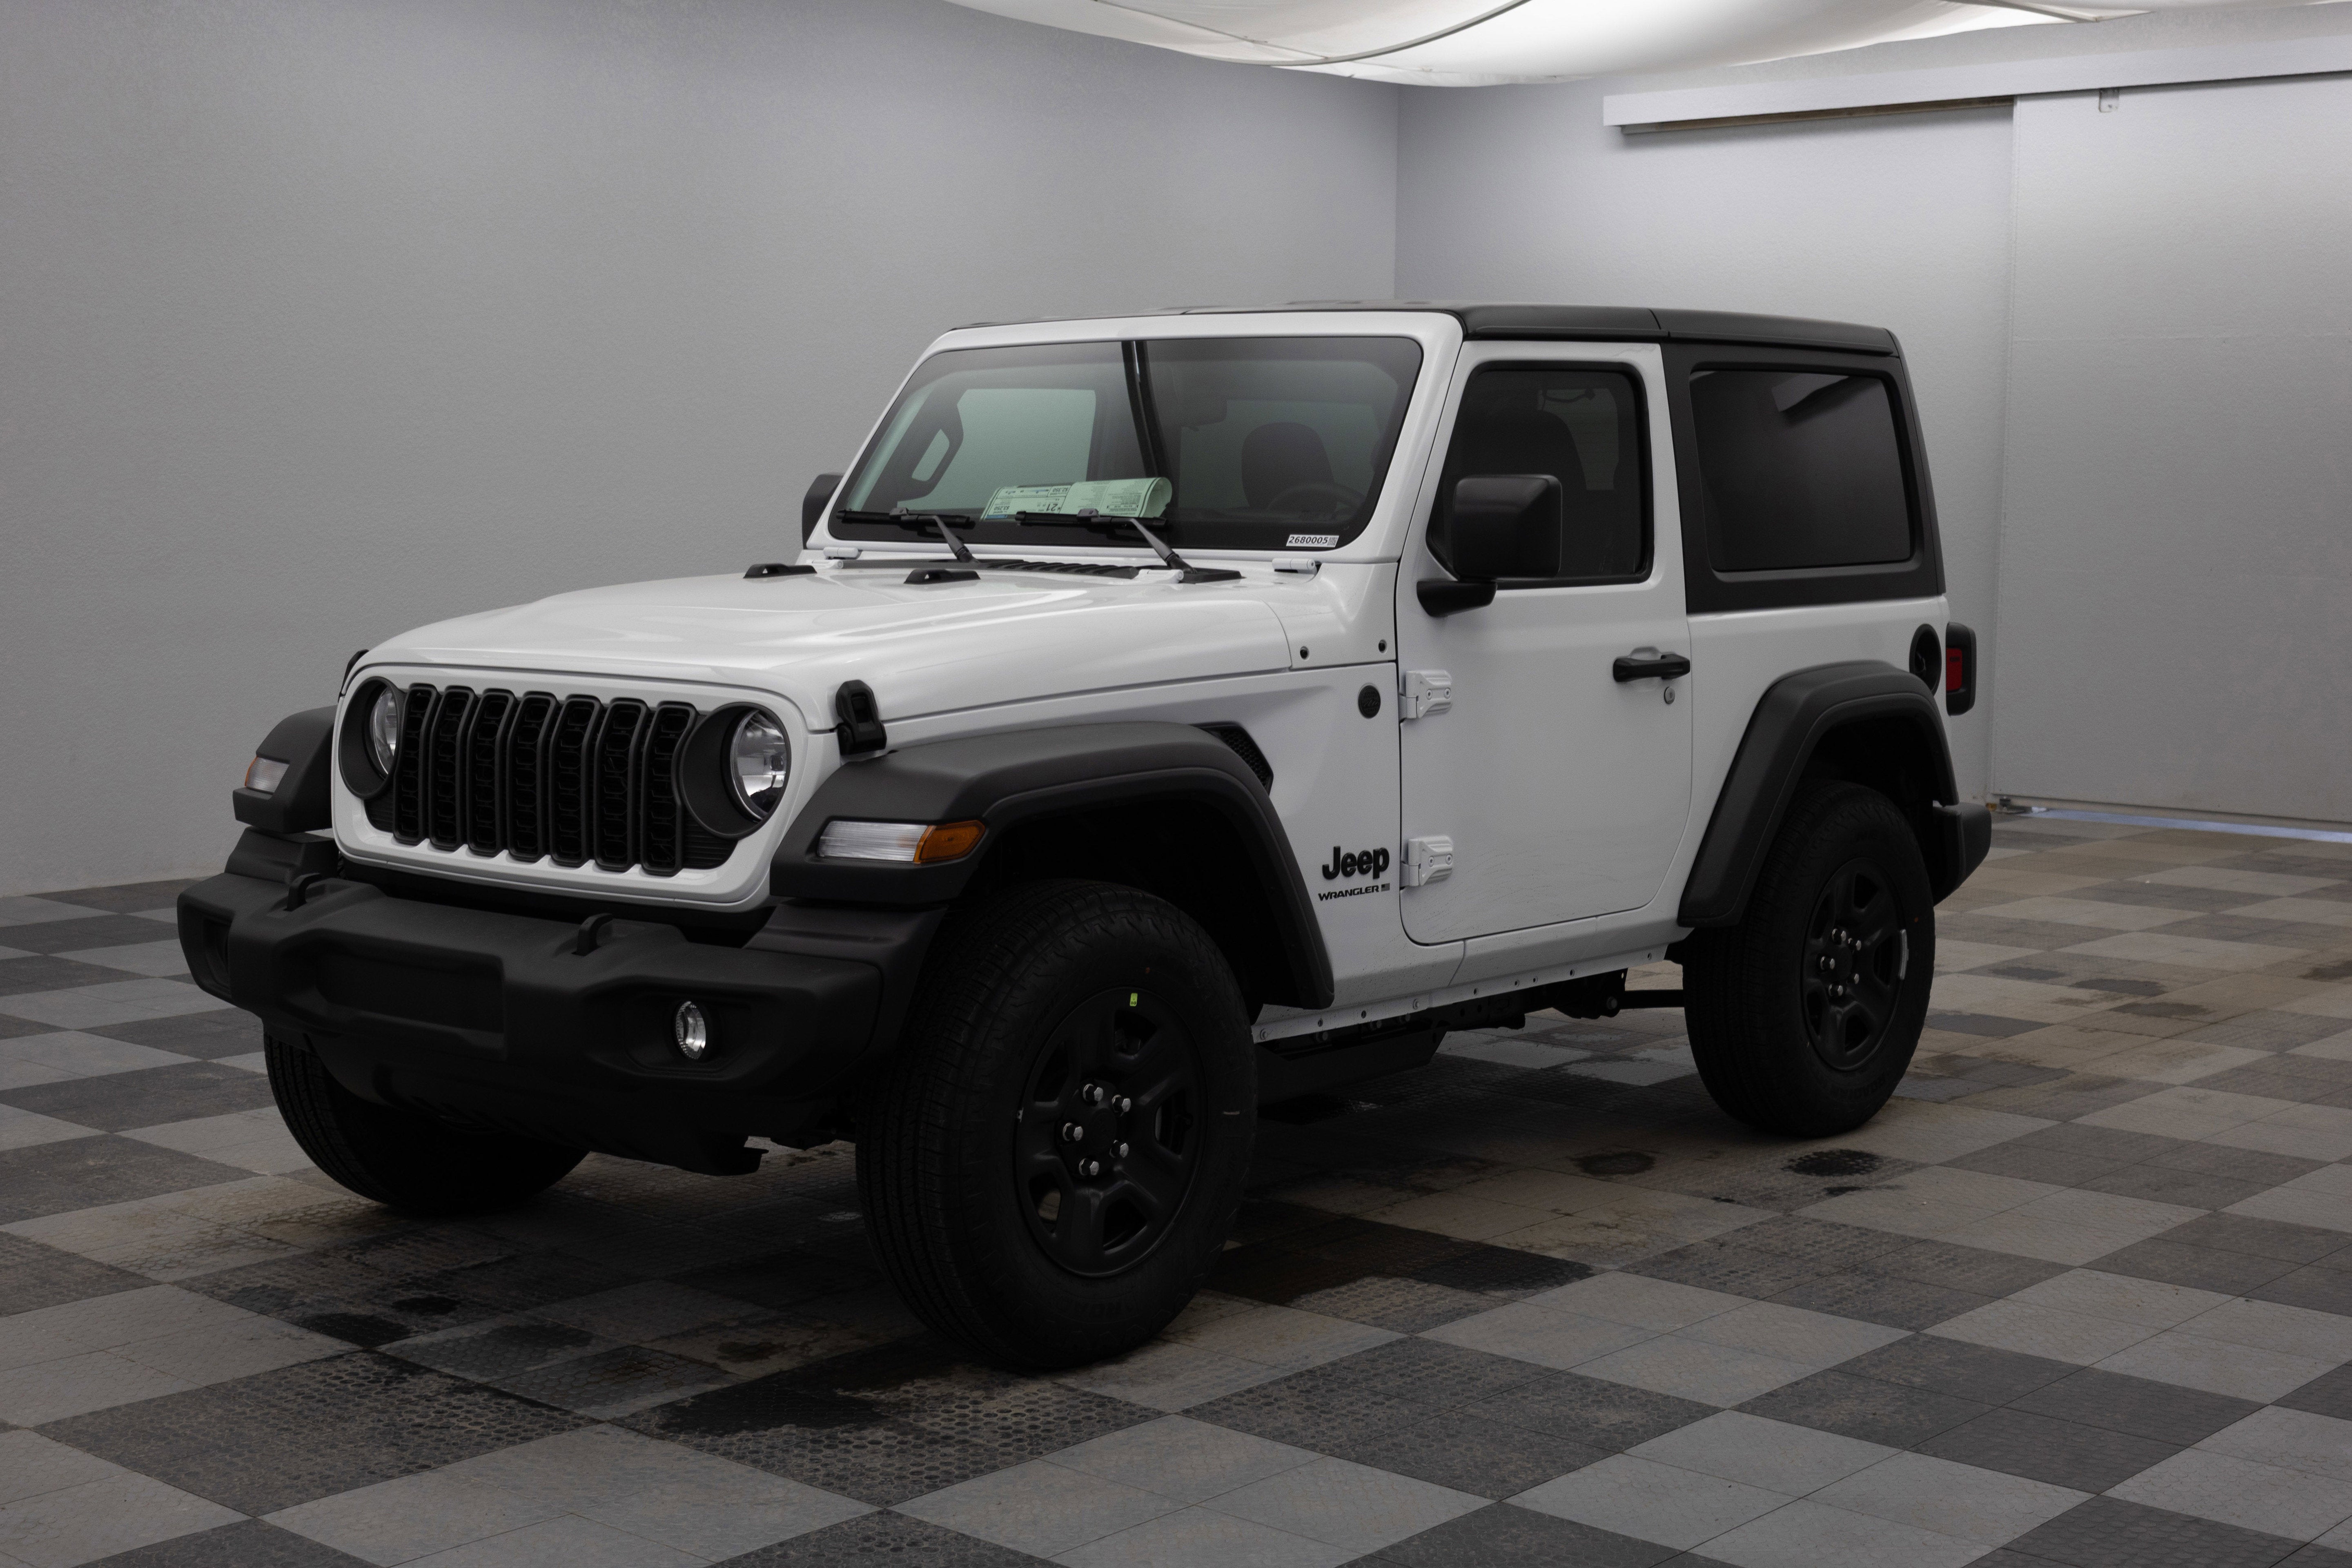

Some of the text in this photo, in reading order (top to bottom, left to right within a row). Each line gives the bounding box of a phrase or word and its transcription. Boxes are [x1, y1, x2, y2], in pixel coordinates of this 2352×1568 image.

[1045, 503, 1058, 512] 21
[1322, 845, 1390, 880] Jeep
[1318, 884, 1379, 901] WRANGLER
